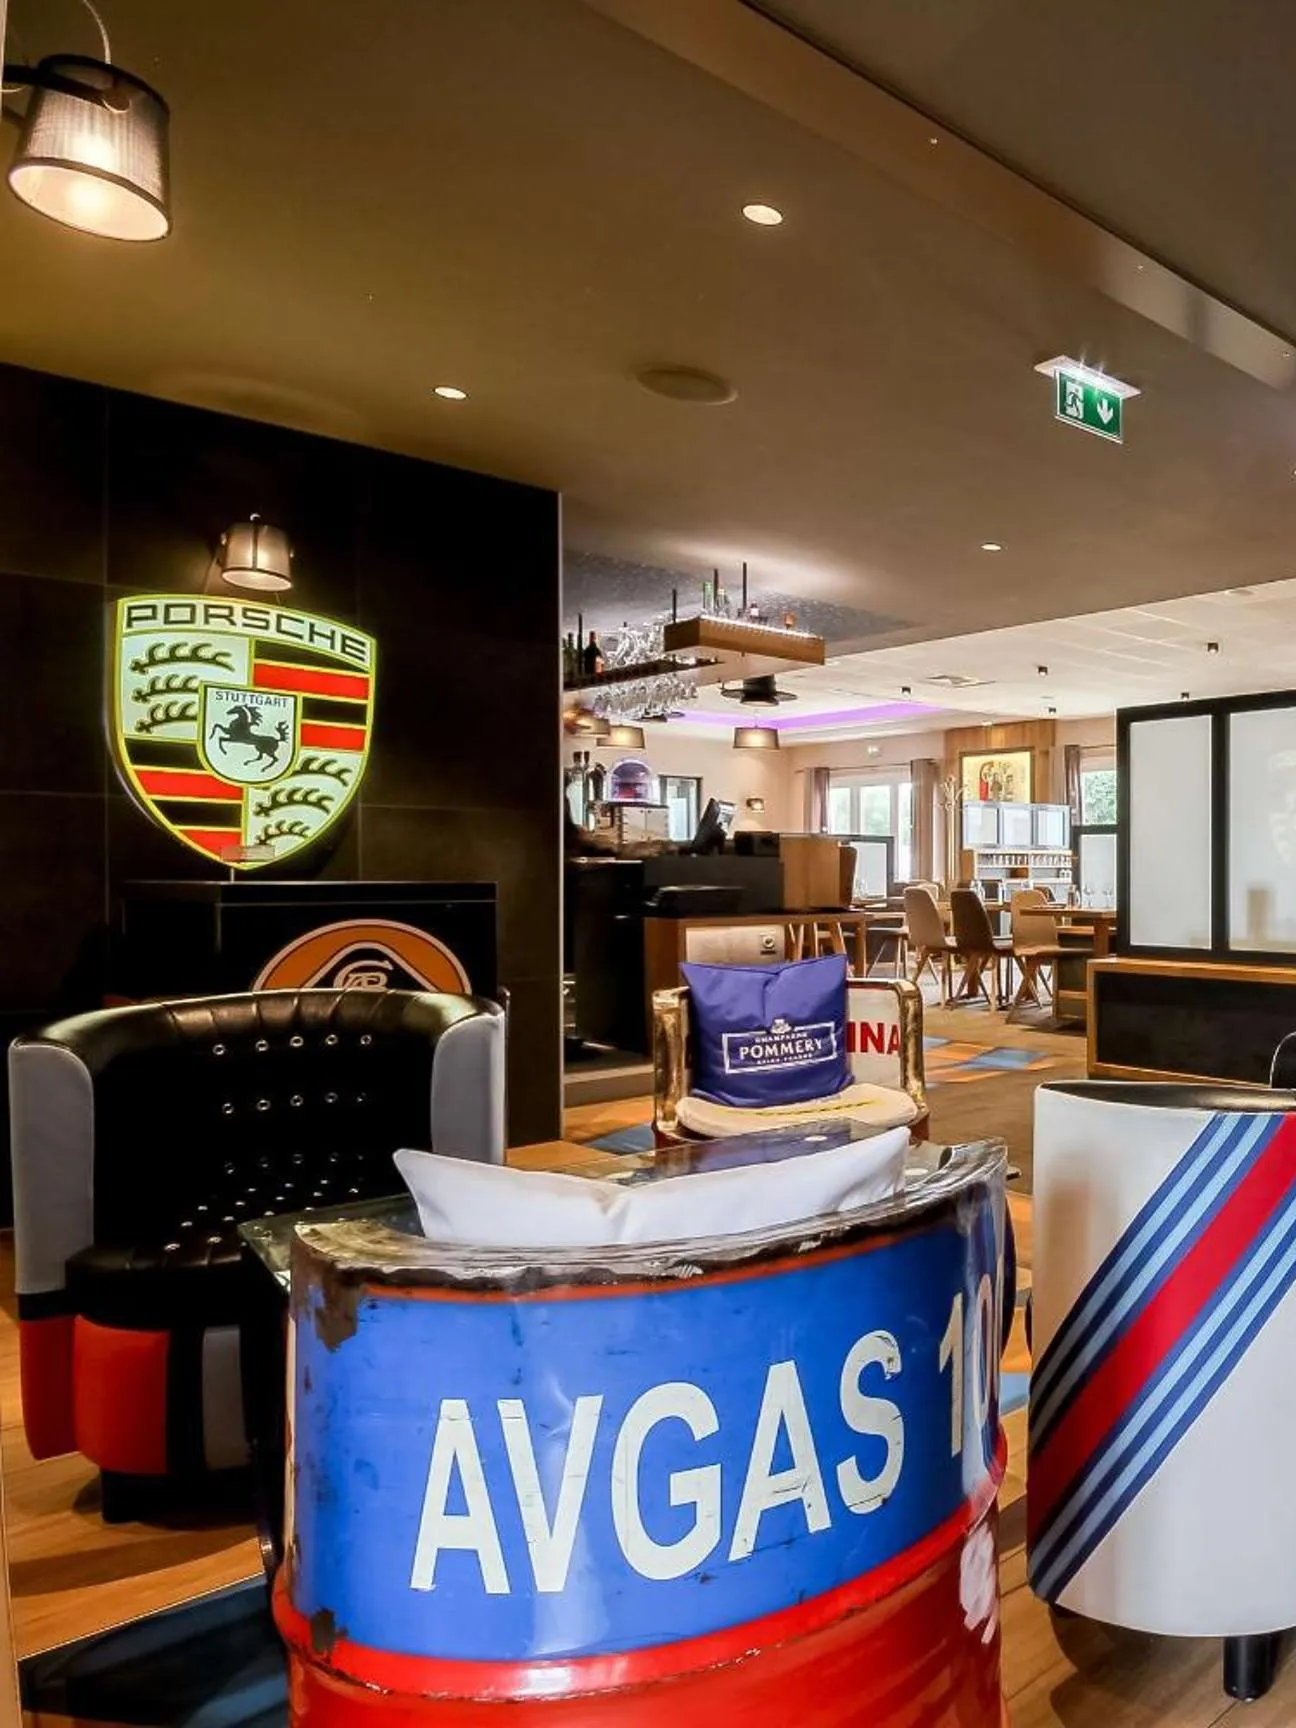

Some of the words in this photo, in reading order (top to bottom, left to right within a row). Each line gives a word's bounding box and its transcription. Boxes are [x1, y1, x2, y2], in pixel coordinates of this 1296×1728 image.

[125, 602, 367, 663] PORSCHE
[215, 690, 289, 708] STUTTGART
[739, 1038, 823, 1060] POMMERY
[409, 1329, 904, 1594] AVGAS
